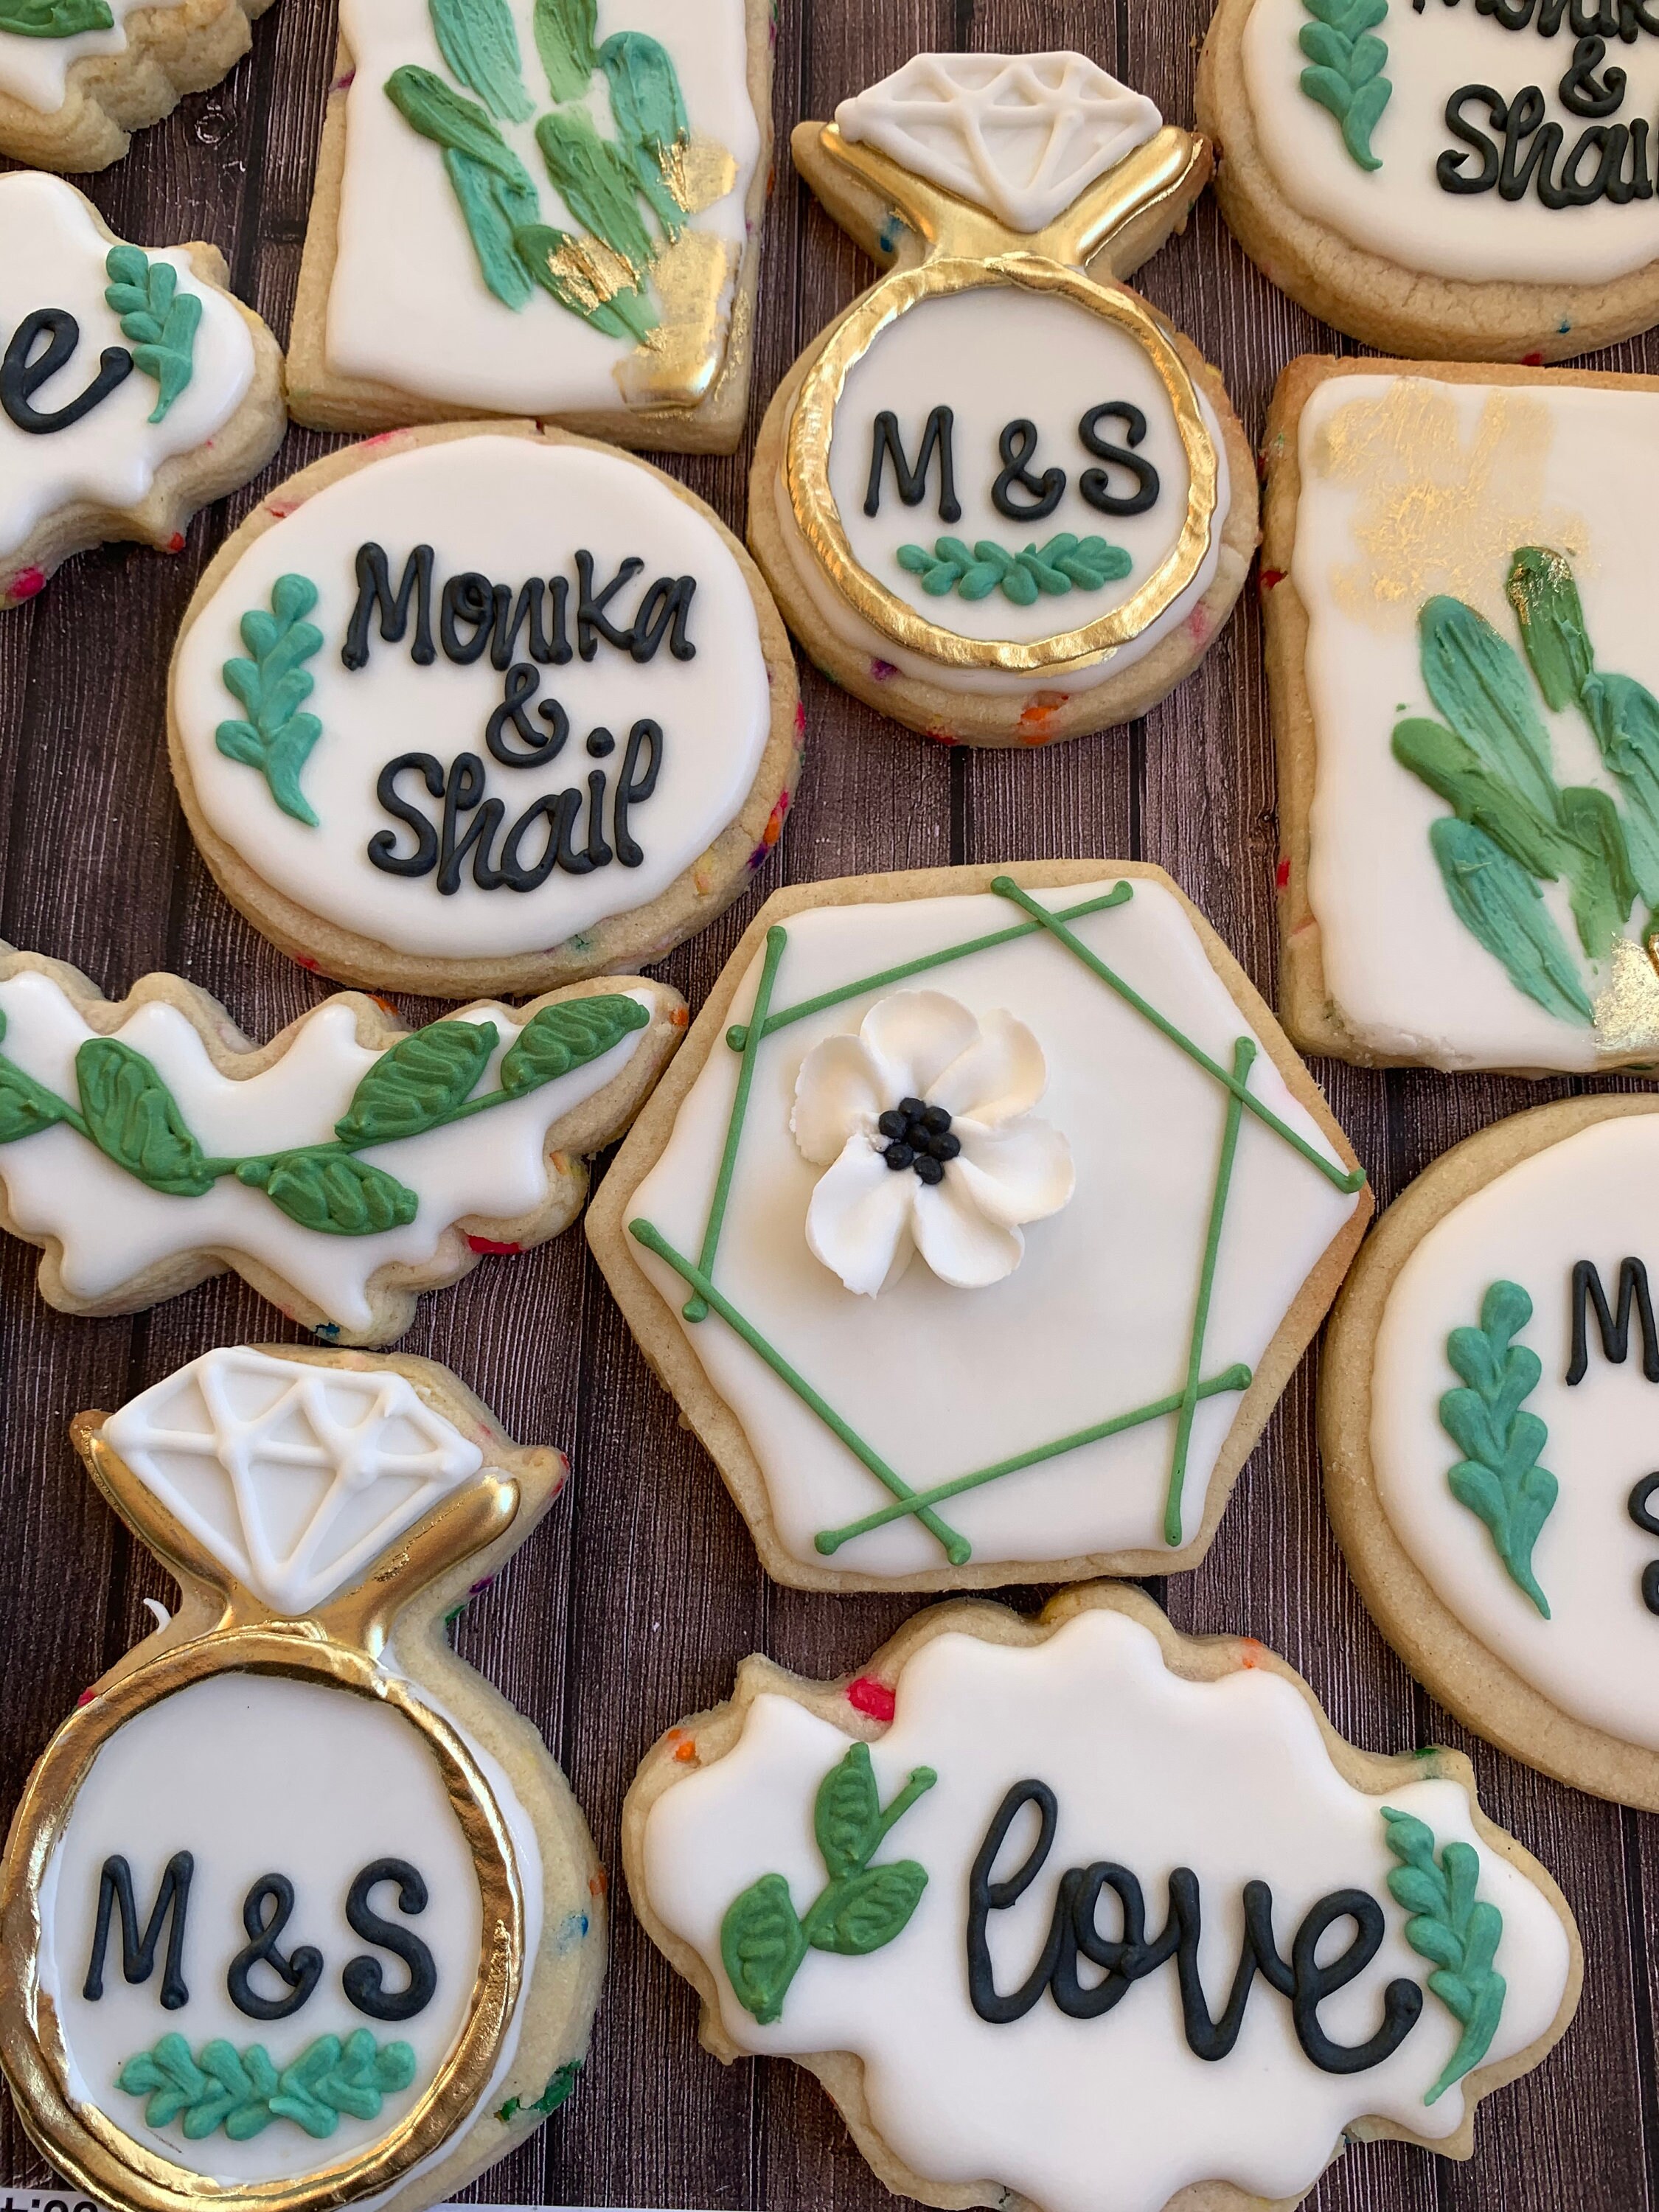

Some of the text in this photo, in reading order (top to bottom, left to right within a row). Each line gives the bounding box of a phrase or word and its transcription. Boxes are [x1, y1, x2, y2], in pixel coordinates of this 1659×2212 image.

[1559, 35, 1627, 118] &
[1436, 83, 1659, 209] Shai
[863, 401, 1160, 524] M & S
[341, 542, 697, 671] Monika
[486, 663, 569, 768] &
[367, 719, 663, 895] Shail
[83, 1850, 437, 2021] M & S
[967, 1778, 1423, 2075] love
